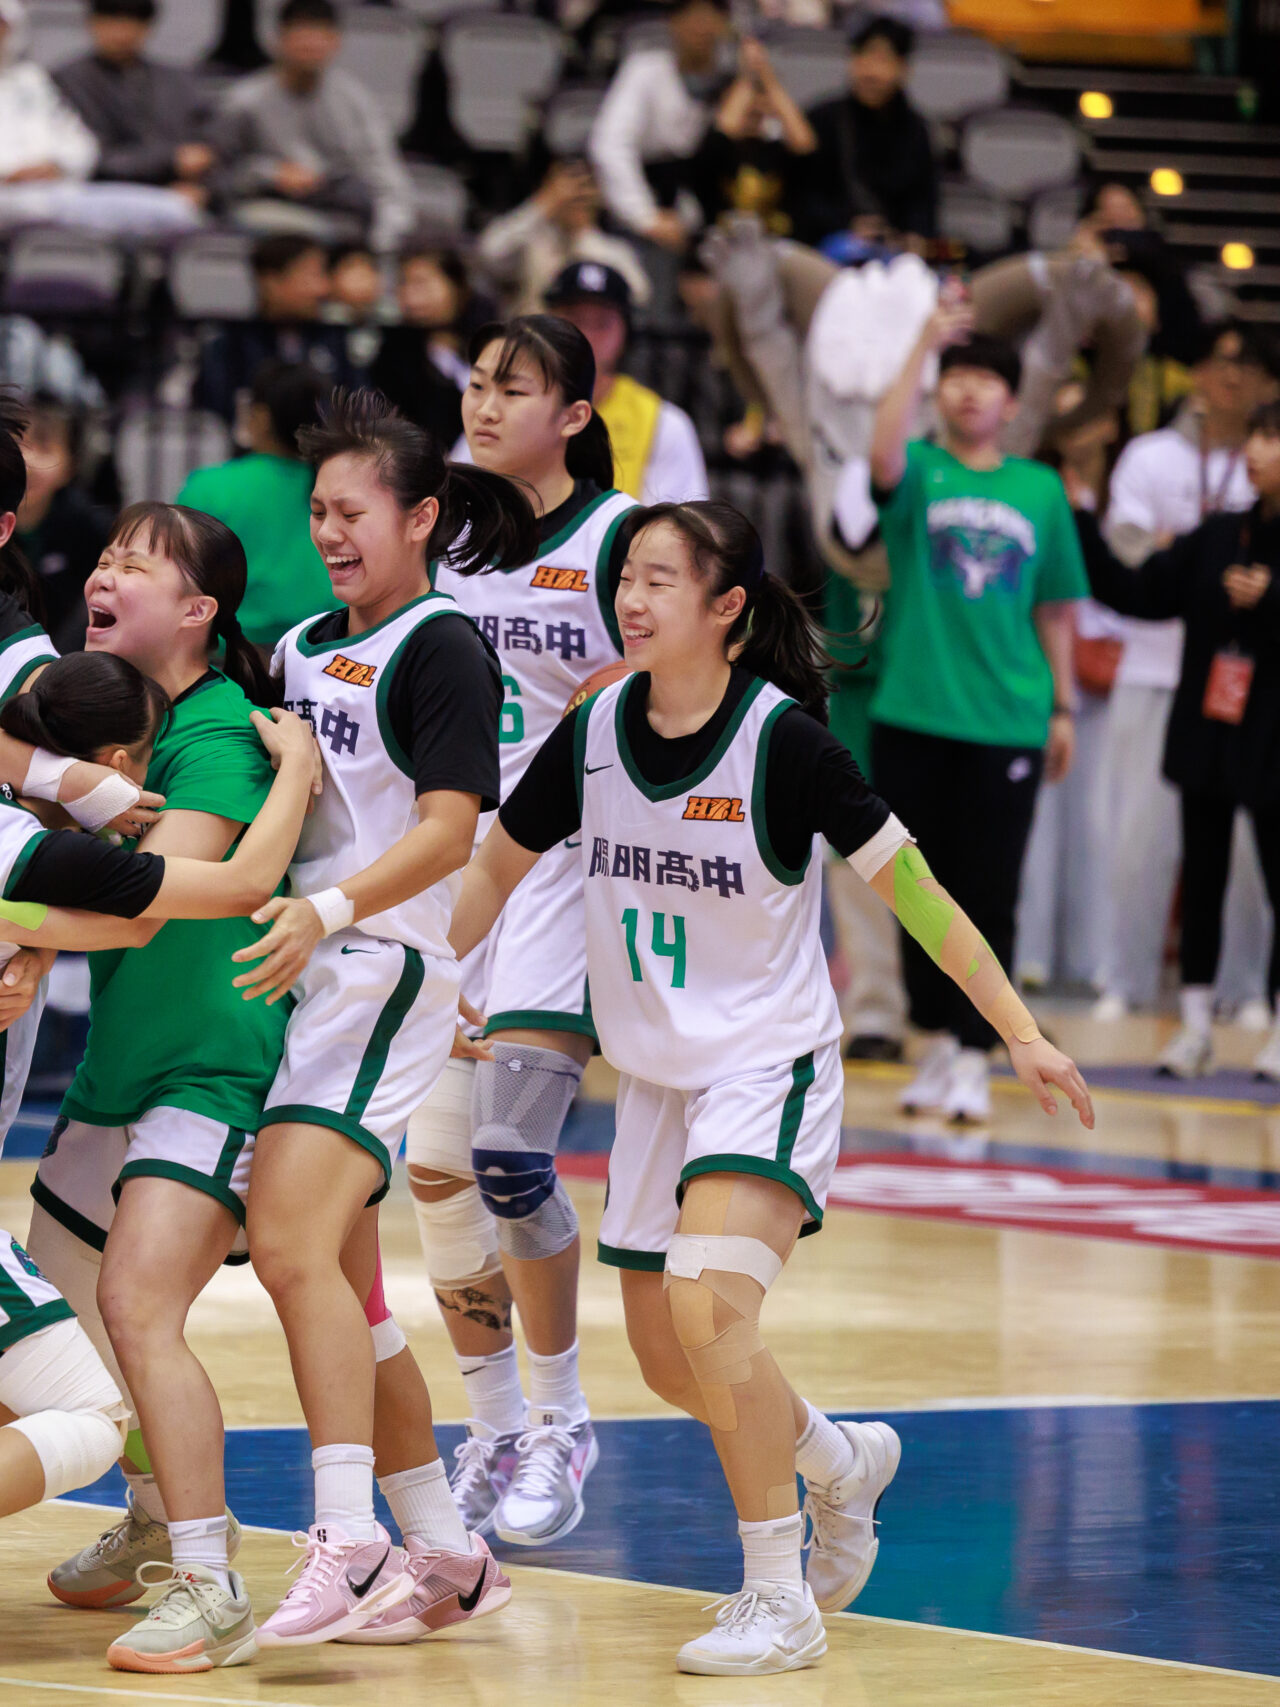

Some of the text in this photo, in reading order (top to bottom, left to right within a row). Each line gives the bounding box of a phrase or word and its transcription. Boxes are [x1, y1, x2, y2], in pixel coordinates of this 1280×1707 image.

[529, 565, 589, 592] HBL
[321, 653, 378, 688] HBL
[682, 795, 746, 822] HBL
[621, 908, 687, 989] 14
